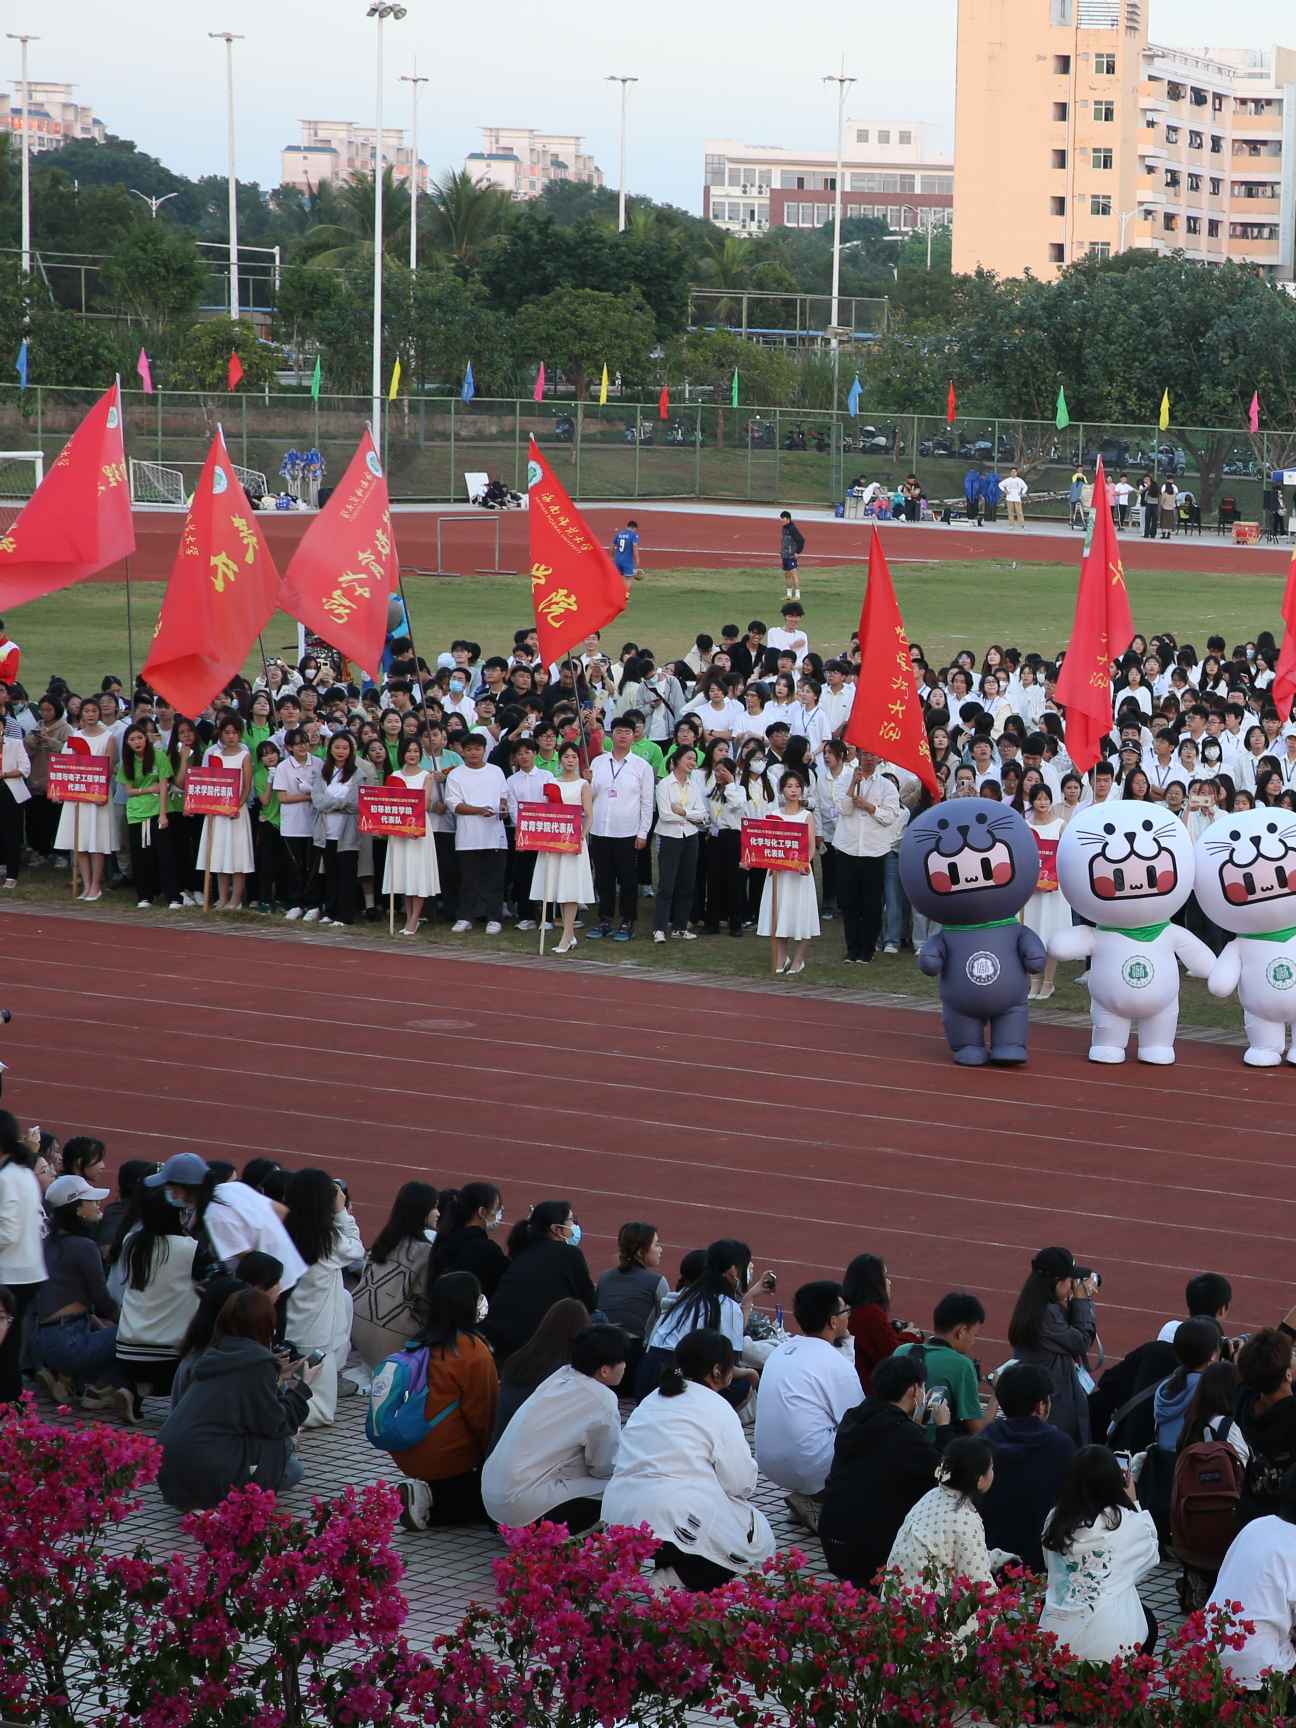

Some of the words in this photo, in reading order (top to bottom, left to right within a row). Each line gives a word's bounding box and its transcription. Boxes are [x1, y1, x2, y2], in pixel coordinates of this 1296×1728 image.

[541, 492, 594, 551] 海南师范大学
[619, 539, 625, 552] 9
[520, 820, 575, 834] 教育学院代表队
[750, 837, 799, 849] 化学与化工学院
[764, 848, 785, 858] 代表队
